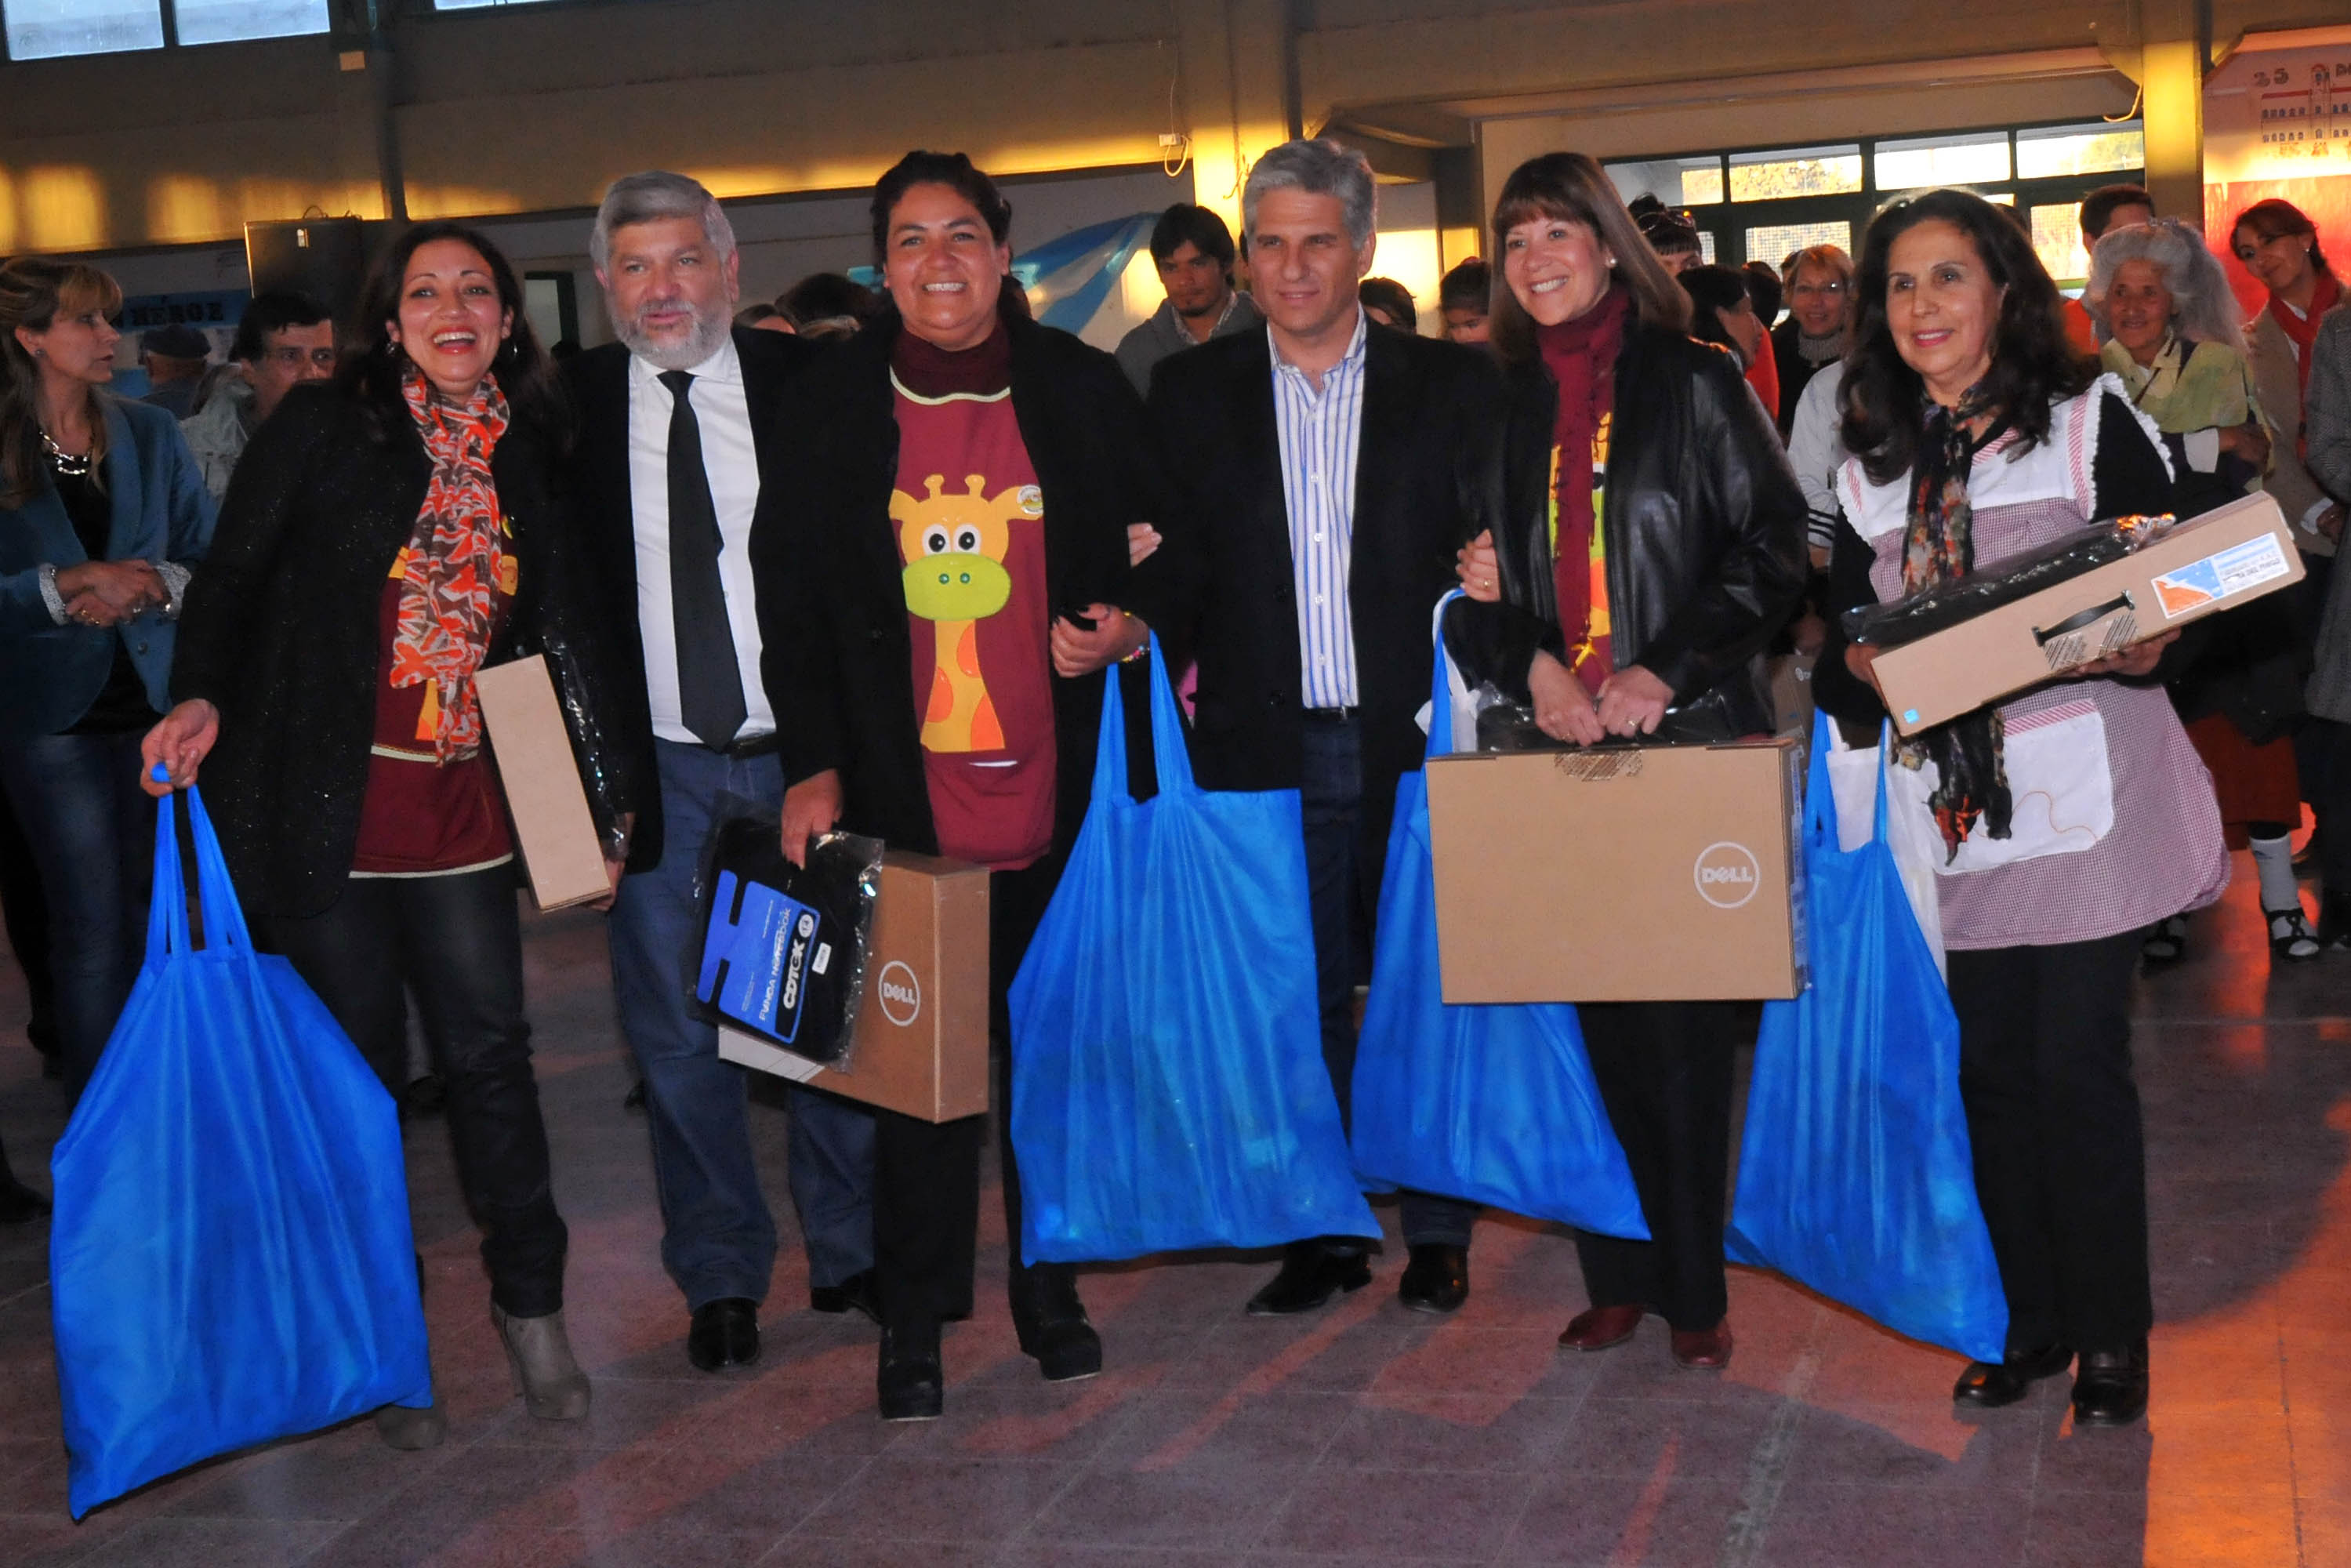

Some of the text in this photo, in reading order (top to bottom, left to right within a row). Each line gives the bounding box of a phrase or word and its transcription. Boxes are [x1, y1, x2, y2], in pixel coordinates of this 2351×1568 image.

[1701, 866, 1754, 884] DELL
[758, 978, 777, 1022] FUNDA
[883, 982, 916, 1005] DELL
